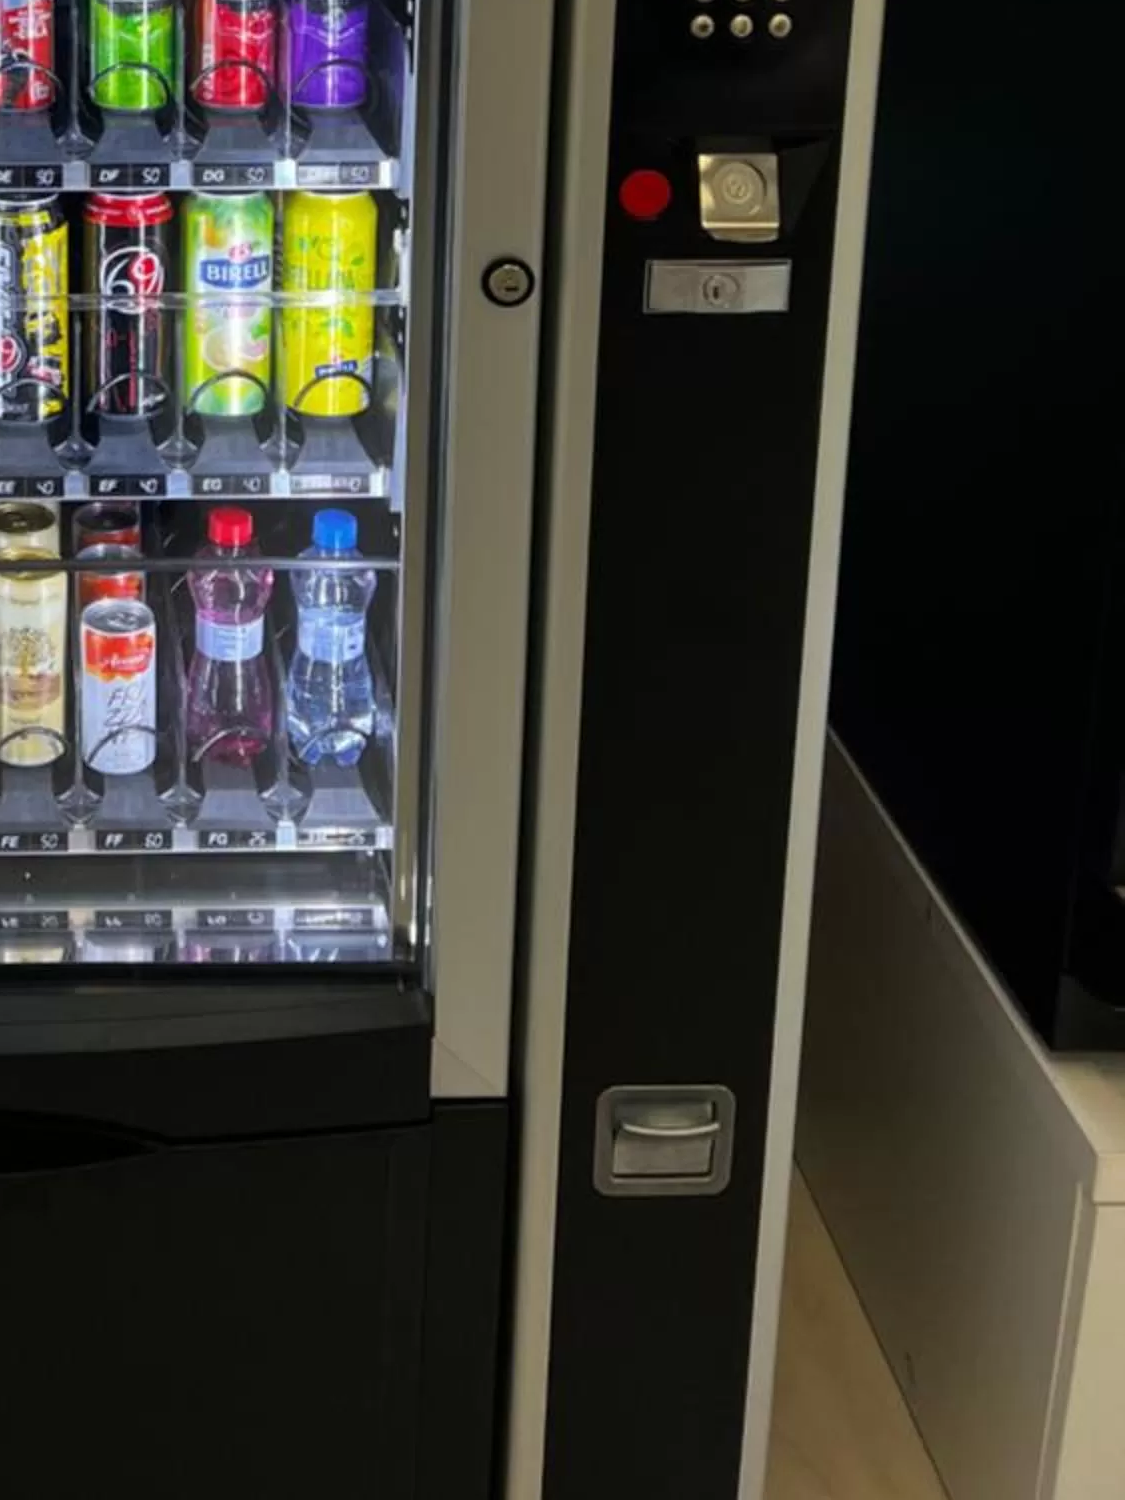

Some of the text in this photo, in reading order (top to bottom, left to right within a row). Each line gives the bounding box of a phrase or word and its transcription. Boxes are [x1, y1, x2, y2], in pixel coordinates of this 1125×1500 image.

[98, 169, 119, 183] DF
[202, 168, 264, 183] DG 50
[206, 259, 268, 283] BIRELL
[98, 480, 116, 493] EF
[202, 477, 262, 493] EG 40
[0, 835, 20, 848] FE
[105, 834, 123, 848] FF
[208, 832, 228, 845] FG
